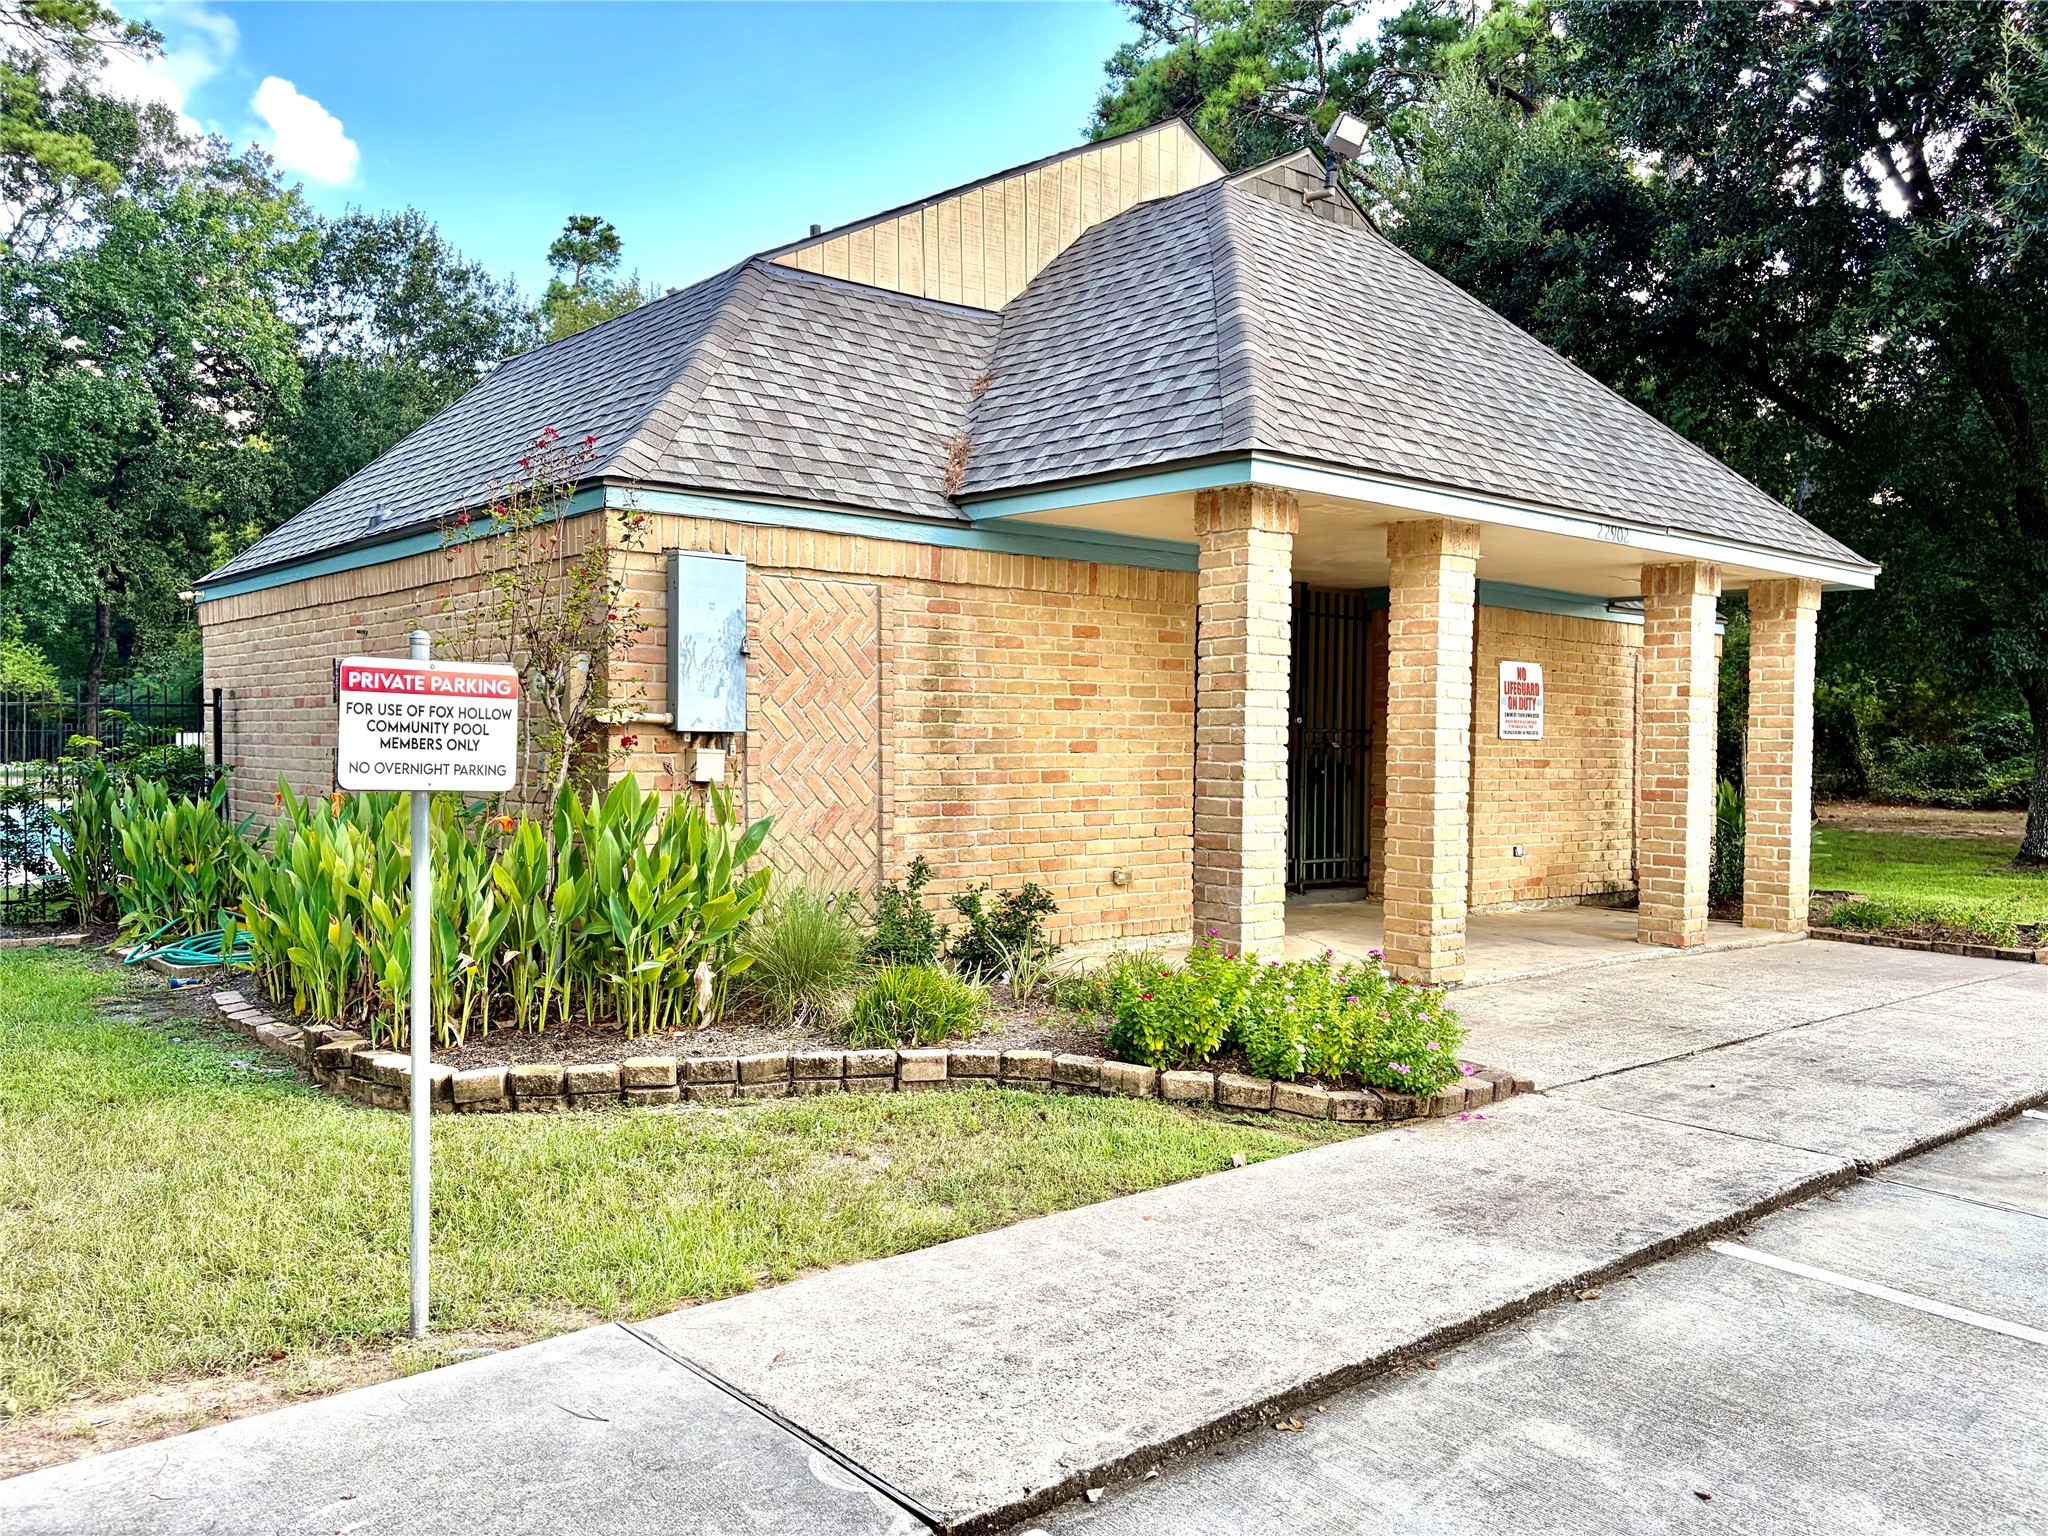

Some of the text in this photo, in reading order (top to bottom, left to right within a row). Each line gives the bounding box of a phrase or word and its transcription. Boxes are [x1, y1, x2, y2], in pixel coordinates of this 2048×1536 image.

[1598, 523, 1629, 543] 22902
[1516, 666, 1527, 681] NO
[348, 671, 512, 695] PRIVATE PARKING
[1503, 681, 1540, 696] LIFEGUARD
[346, 701, 512, 720] FOR USE OF FOX HOLLOW
[1507, 696, 1537, 711] ON DUTY
[366, 719, 489, 736] COMMUNITY POOL
[380, 737, 480, 751] MEMBERS ONLY
[349, 761, 507, 776] NO OVERNIGHT PARKING
